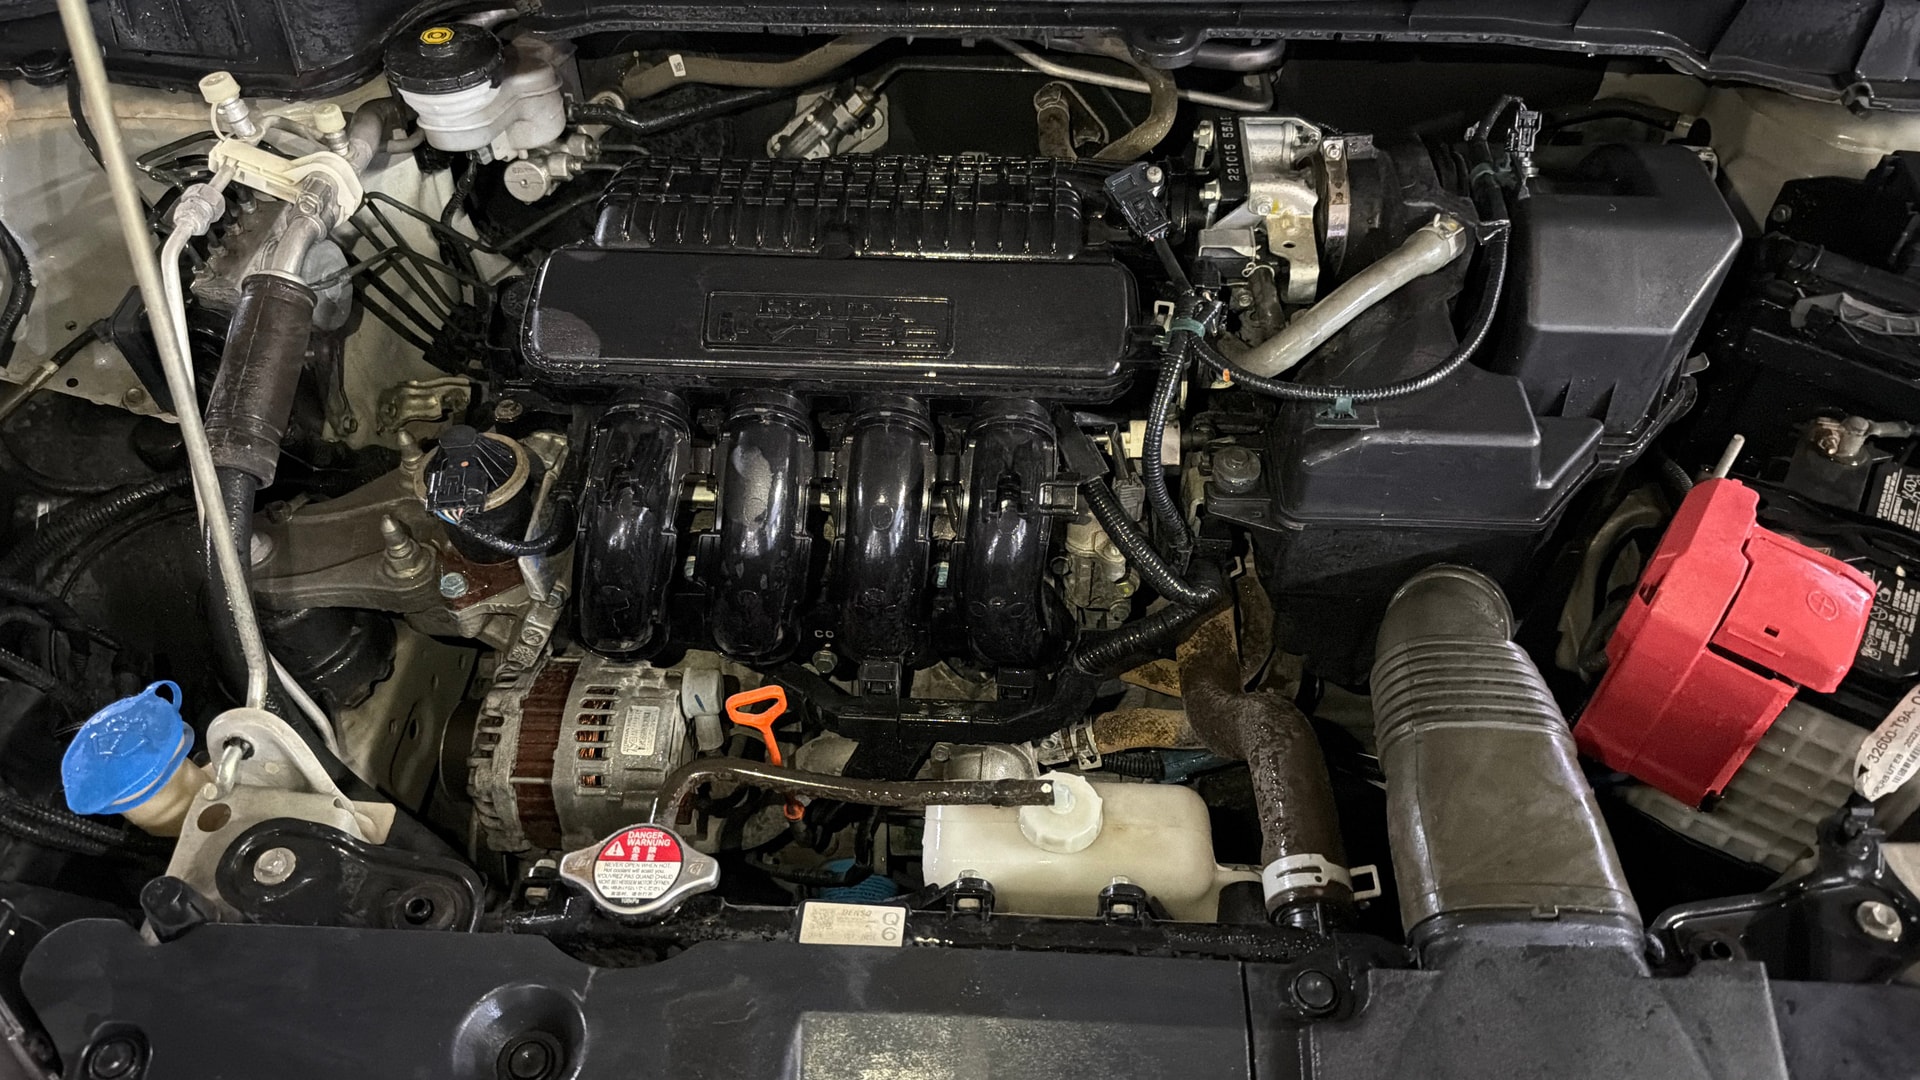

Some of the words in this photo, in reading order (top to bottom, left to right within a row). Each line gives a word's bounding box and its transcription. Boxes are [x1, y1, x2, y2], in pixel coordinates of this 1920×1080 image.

[1223, 144, 1241, 182] 221015
[628, 831, 664, 839] DANGER
[627, 838, 671, 847] WARNUNG
[841, 909, 873, 917] DENSO
[881, 927, 897, 941] 6
